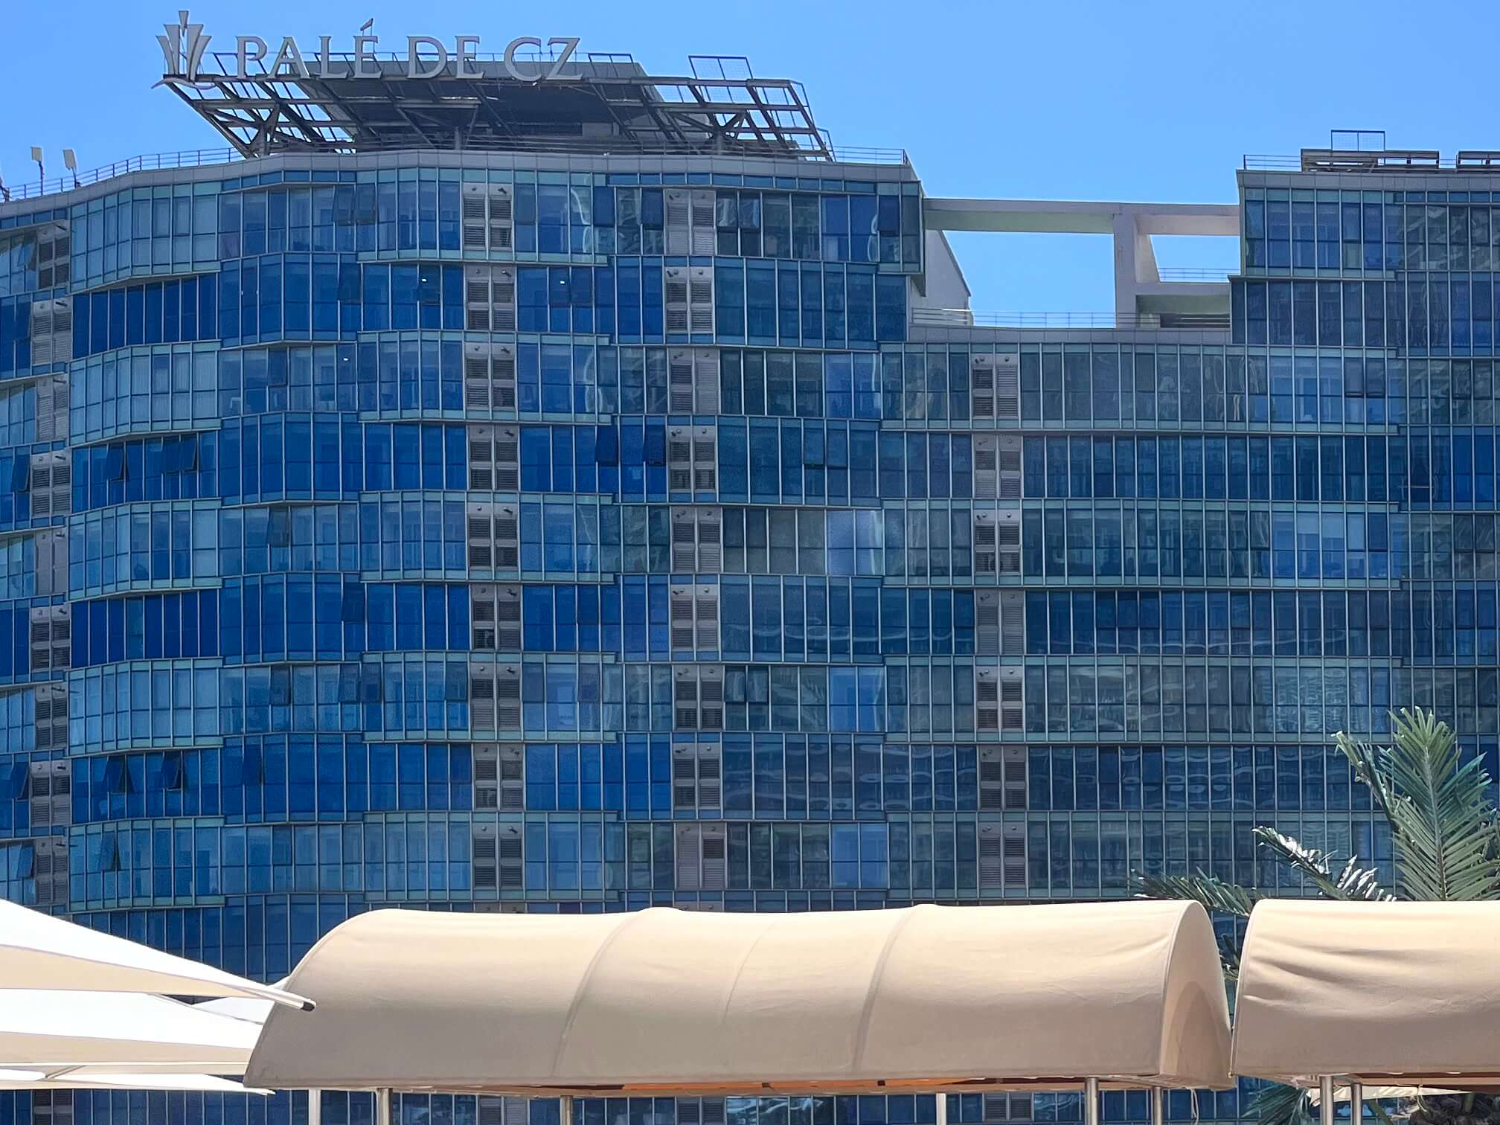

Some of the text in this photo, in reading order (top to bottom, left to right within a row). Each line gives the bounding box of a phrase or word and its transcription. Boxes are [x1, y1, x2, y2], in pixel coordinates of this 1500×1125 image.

[237, 18, 585, 82] PALÉ DE CZ
